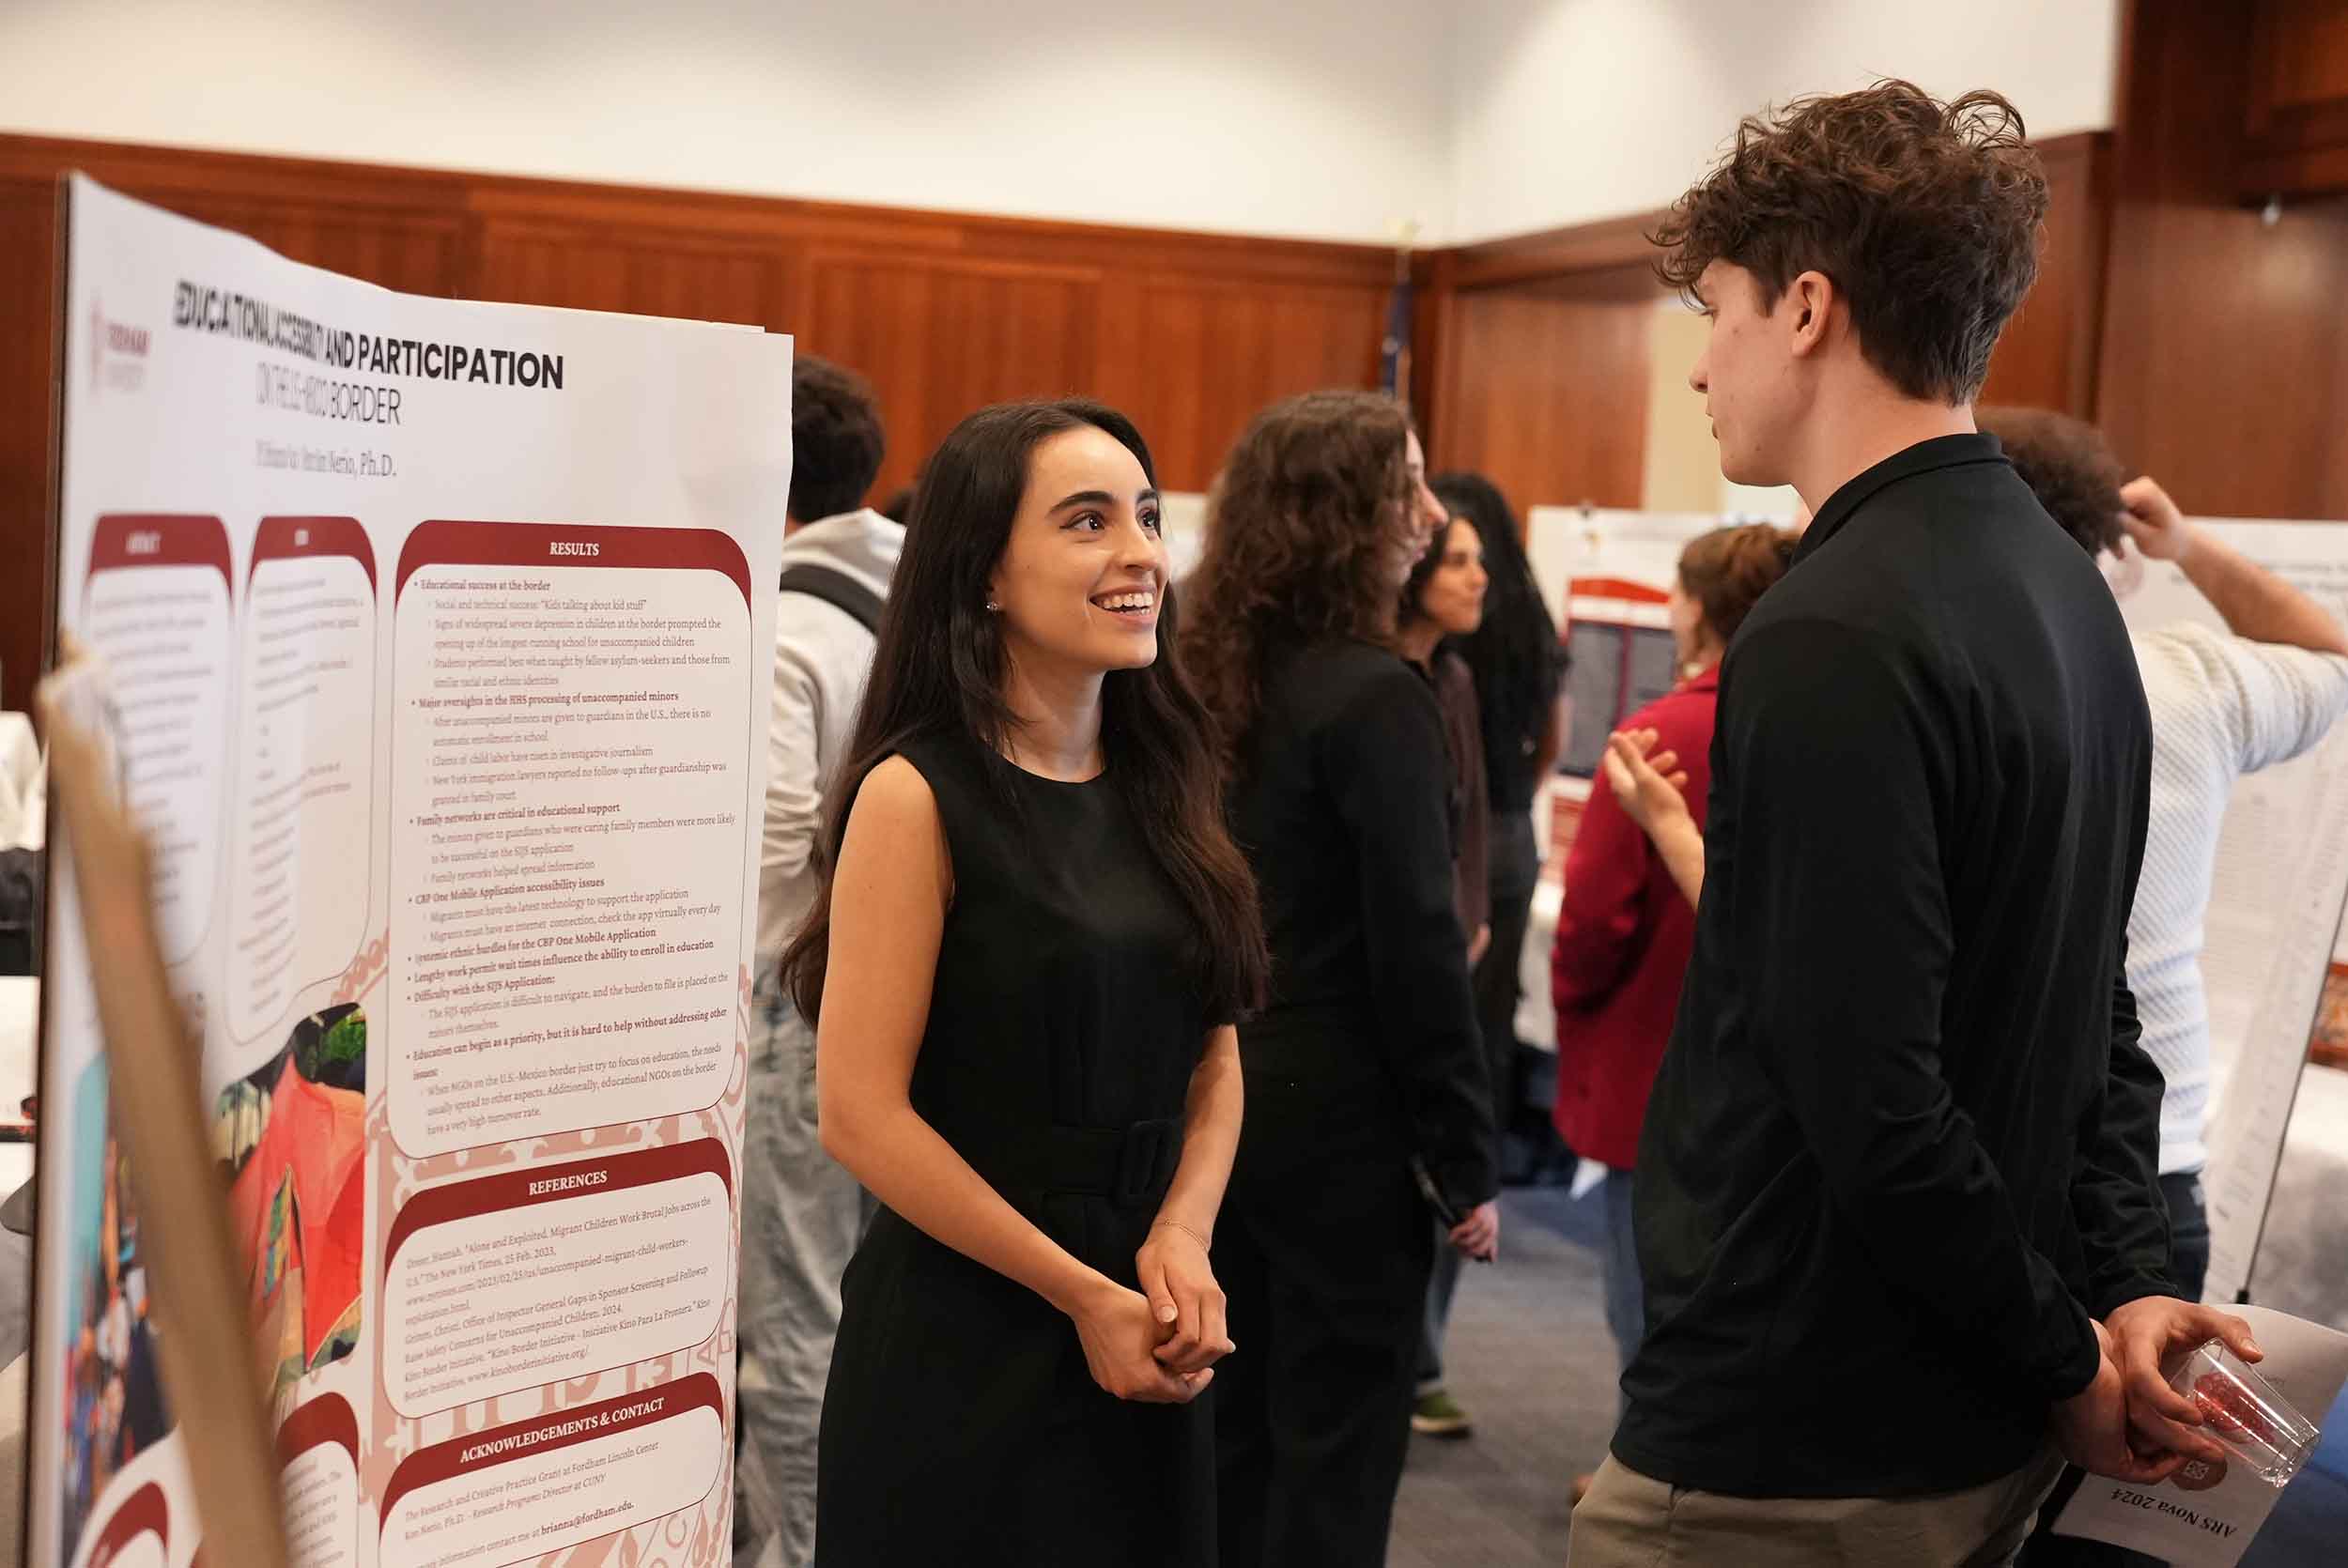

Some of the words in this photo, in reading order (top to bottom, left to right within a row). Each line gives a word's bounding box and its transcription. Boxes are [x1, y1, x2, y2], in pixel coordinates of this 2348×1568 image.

[326, 330, 354, 368] AND
[359, 333, 564, 390] PARTICIPATION
[332, 380, 401, 425] BORDER
[361, 451, 397, 477] Ph.D.
[549, 542, 600, 556] RESULTS
[509, 581, 521, 591] the
[523, 581, 550, 591] border
[589, 600, 611, 609] about
[612, 600, 623, 609] kid
[626, 620, 639, 629] the
[641, 620, 666, 629] border
[667, 620, 706, 631] prompted
[708, 620, 721, 629] the
[662, 638, 695, 647] children
[672, 655, 687, 665] and
[687, 655, 710, 665] those
[710, 655, 730, 665] from
[573, 694, 581, 703] of
[582, 692, 647, 704] unaccompanied
[649, 692, 679, 701] minors
[626, 711, 634, 720] in
[635, 710, 648, 720] the
[670, 709, 690, 719] there
[692, 709, 699, 718] is
[639, 765, 657, 775] after
[659, 762, 711, 776] guardianship
[527, 808, 535, 818] in
[536, 805, 585, 817] educational
[586, 803, 620, 816] support
[610, 821, 635, 833] family
[637, 819, 674, 830] members
[717, 814, 735, 826] likely
[527, 880, 577, 893] accessibility
[578, 879, 605, 888] issues
[586, 899, 595, 909] to
[596, 896, 628, 909] support
[630, 894, 644, 904] the
[645, 890, 688, 905] application
[598, 914, 622, 925] check
[623, 913, 637, 923] the
[638, 914, 654, 923] app
[655, 908, 687, 920] virtually
[687, 909, 707, 917] every
[708, 905, 721, 916] day
[507, 942, 519, 952] for
[520, 940, 535, 950] the
[556, 937, 574, 946] One
[575, 933, 606, 945] Mobile
[608, 928, 657, 944] Application
[542, 955, 583, 966] influence
[584, 952, 599, 962] the
[600, 948, 627, 961] ability
[629, 947, 639, 958] to
[640, 945, 666, 957] enroll
[667, 944, 674, 954] in
[676, 940, 714, 953] education
[593, 988, 608, 999] and
[609, 986, 623, 997] the
[624, 983, 654, 995] burden
[655, 981, 663, 992] to
[664, 979, 676, 990] file
[677, 978, 684, 989] is
[686, 976, 709, 990] placed
[720, 973, 729, 983] the
[547, 1030, 562, 1041] but
[563, 1029, 571, 1039] it
[572, 1028, 579, 1038] is
[580, 1024, 601, 1037] hard
[603, 1023, 612, 1034] to
[613, 1022, 633, 1033] help
[634, 1016, 667, 1030] without
[669, 1010, 709, 1024] addressing
[710, 1007, 727, 1019] other
[548, 1067, 576, 1079] border
[577, 1062, 595, 1077] just
[595, 1061, 607, 1073] try
[609, 1059, 617, 1069] to
[618, 1058, 640, 1068] focus
[641, 1056, 651, 1065] on
[691, 1046, 703, 1057] the
[704, 1044, 721, 1055] needs
[601, 1072, 648, 1088] educational
[649, 1069, 671, 1081] NGOs
[672, 1069, 681, 1078] on
[683, 1066, 694, 1076] the
[695, 1062, 717, 1074] border
[529, 1170, 608, 1196] REFERENCES
[584, 1219, 618, 1232] Children
[619, 1212, 641, 1225] Work
[641, 1207, 664, 1222] Brutal
[664, 1205, 680, 1216] Jobs
[681, 1202, 701, 1212] across
[702, 1197, 711, 1208] the
[589, 1291, 597, 1300] in
[598, 1286, 628, 1300] Sponsor
[629, 1277, 665, 1292] Screening
[666, 1272, 678, 1284] and
[618, 1319, 637, 1330] Kino
[638, 1315, 654, 1326] Para
[654, 1311, 662, 1321] La
[460, 1414, 598, 1463] ACKNOWLEDGEMENTS
[600, 1411, 610, 1426] &
[612, 1397, 665, 1422] CONTACT
[538, 1466, 562, 1482] Grant
[563, 1463, 571, 1475] at
[572, 1456, 606, 1472] Fordham
[608, 1447, 634, 1463] Lincoln
[574, 1478, 582, 1490] at
[583, 1471, 606, 1487] CUNY
[2110, 1488, 2155, 1510] 2024
[2157, 1501, 2200, 1526] Nova
[2201, 1516, 2239, 1538] ARS
